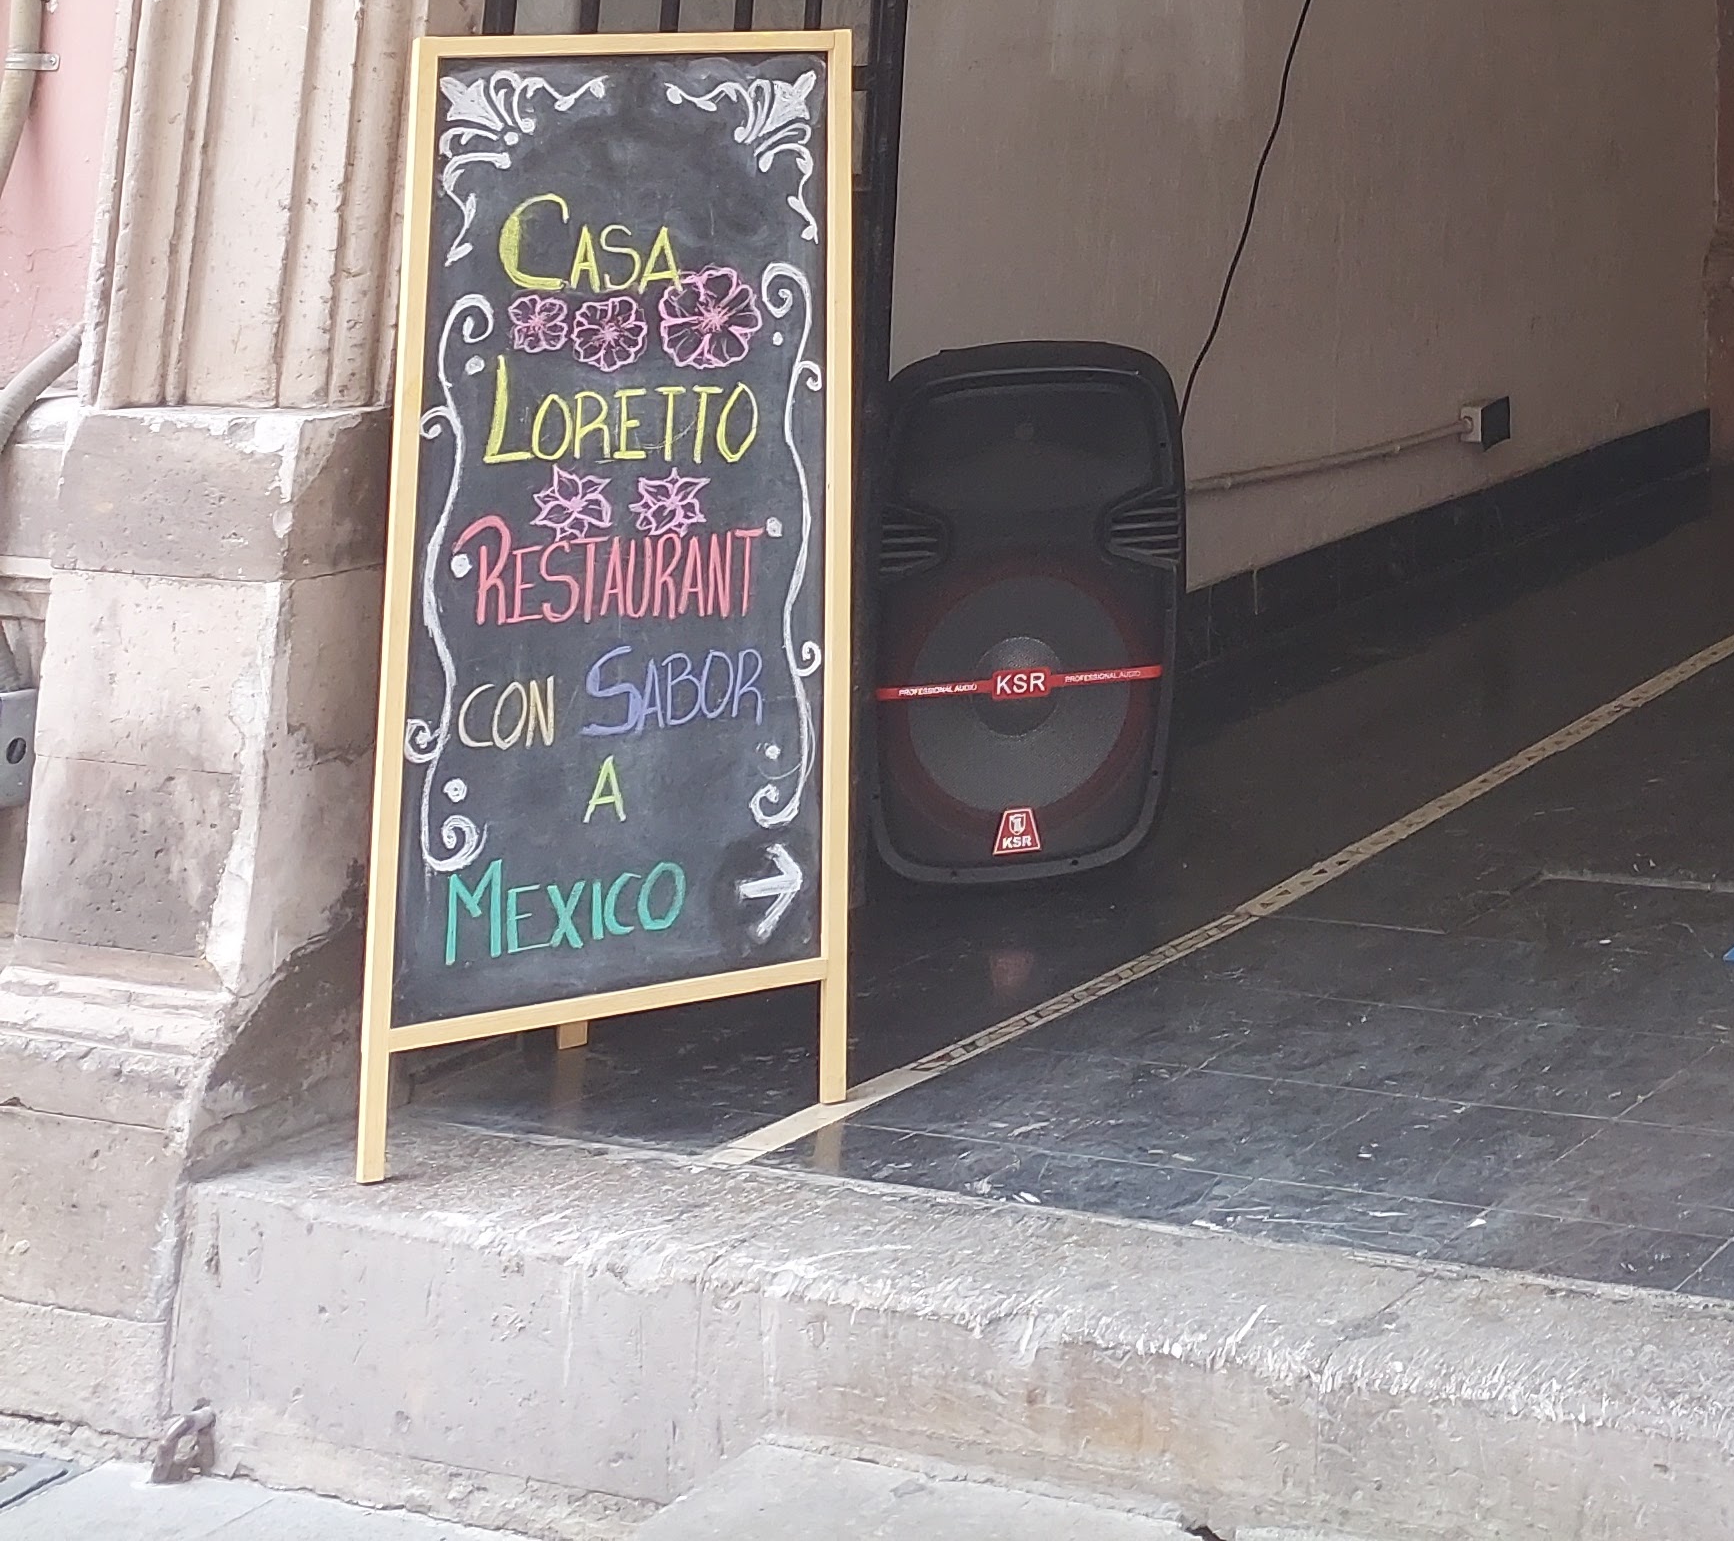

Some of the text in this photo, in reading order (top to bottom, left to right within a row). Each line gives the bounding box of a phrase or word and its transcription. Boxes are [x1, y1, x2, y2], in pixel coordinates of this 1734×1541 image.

[499, 193, 683, 294] CASA
[483, 355, 758, 463] LORETTO
[453, 516, 765, 625] RESTAURANT
[458, 645, 763, 750] CON SABOR
[996, 672, 1046, 695] KSR
[583, 755, 626, 824] A
[1002, 836, 1032, 849] KSR
[445, 858, 687, 965] MEXICO
